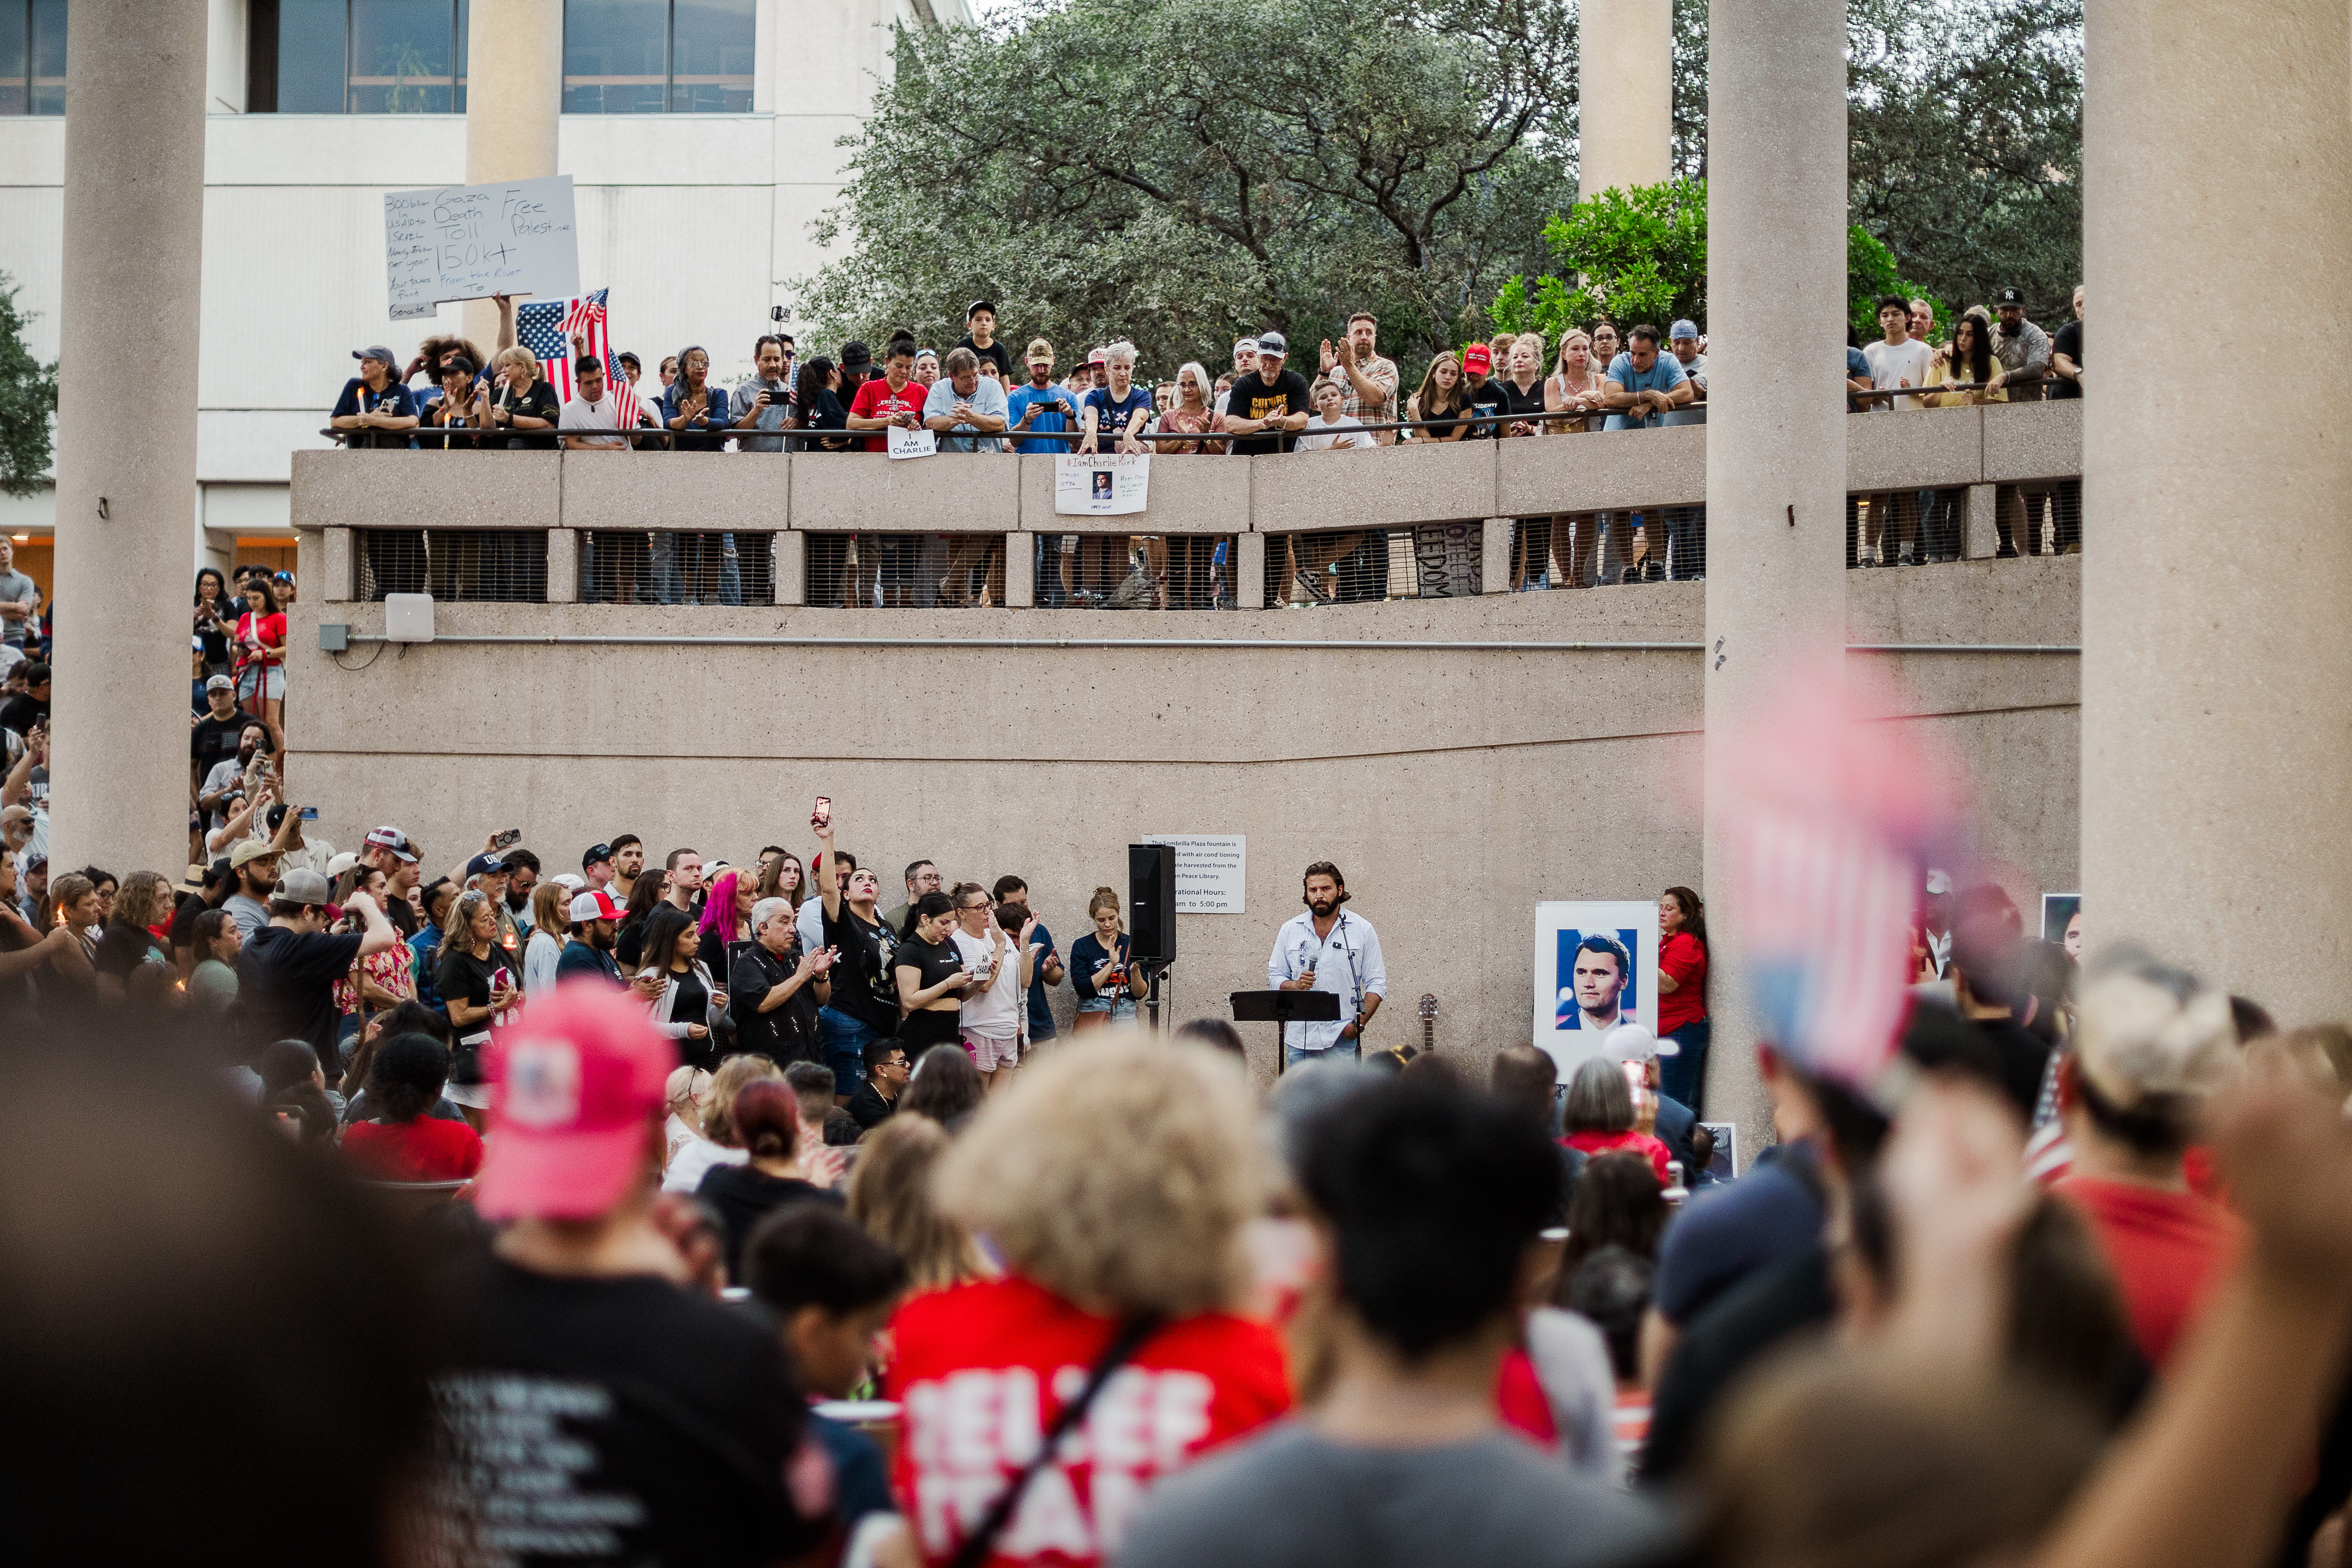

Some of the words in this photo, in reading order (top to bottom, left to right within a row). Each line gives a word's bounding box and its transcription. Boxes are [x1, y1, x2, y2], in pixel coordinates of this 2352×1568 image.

[435, 190, 490, 206] Gaza
[501, 189, 546, 220] Free
[433, 206, 482, 223] Death
[435, 221, 478, 240] Toll
[510, 213, 571, 237] Palestine
[388, 230, 424, 244] ISRAEL
[388, 261, 403, 272] per
[406, 258, 430, 271] year
[388, 276, 407, 292] Your
[409, 275, 431, 286] taxes
[440, 274, 465, 288] From
[470, 270, 490, 281] the
[493, 268, 522, 279] River
[463, 283, 484, 293] To
[2005, 290, 2014, 299] NY
[1252, 394, 1287, 408] CULTURE
[893, 446, 931, 454] CHARLIE
[483, 854, 501, 864] US
[982, 954, 988, 963] AM
